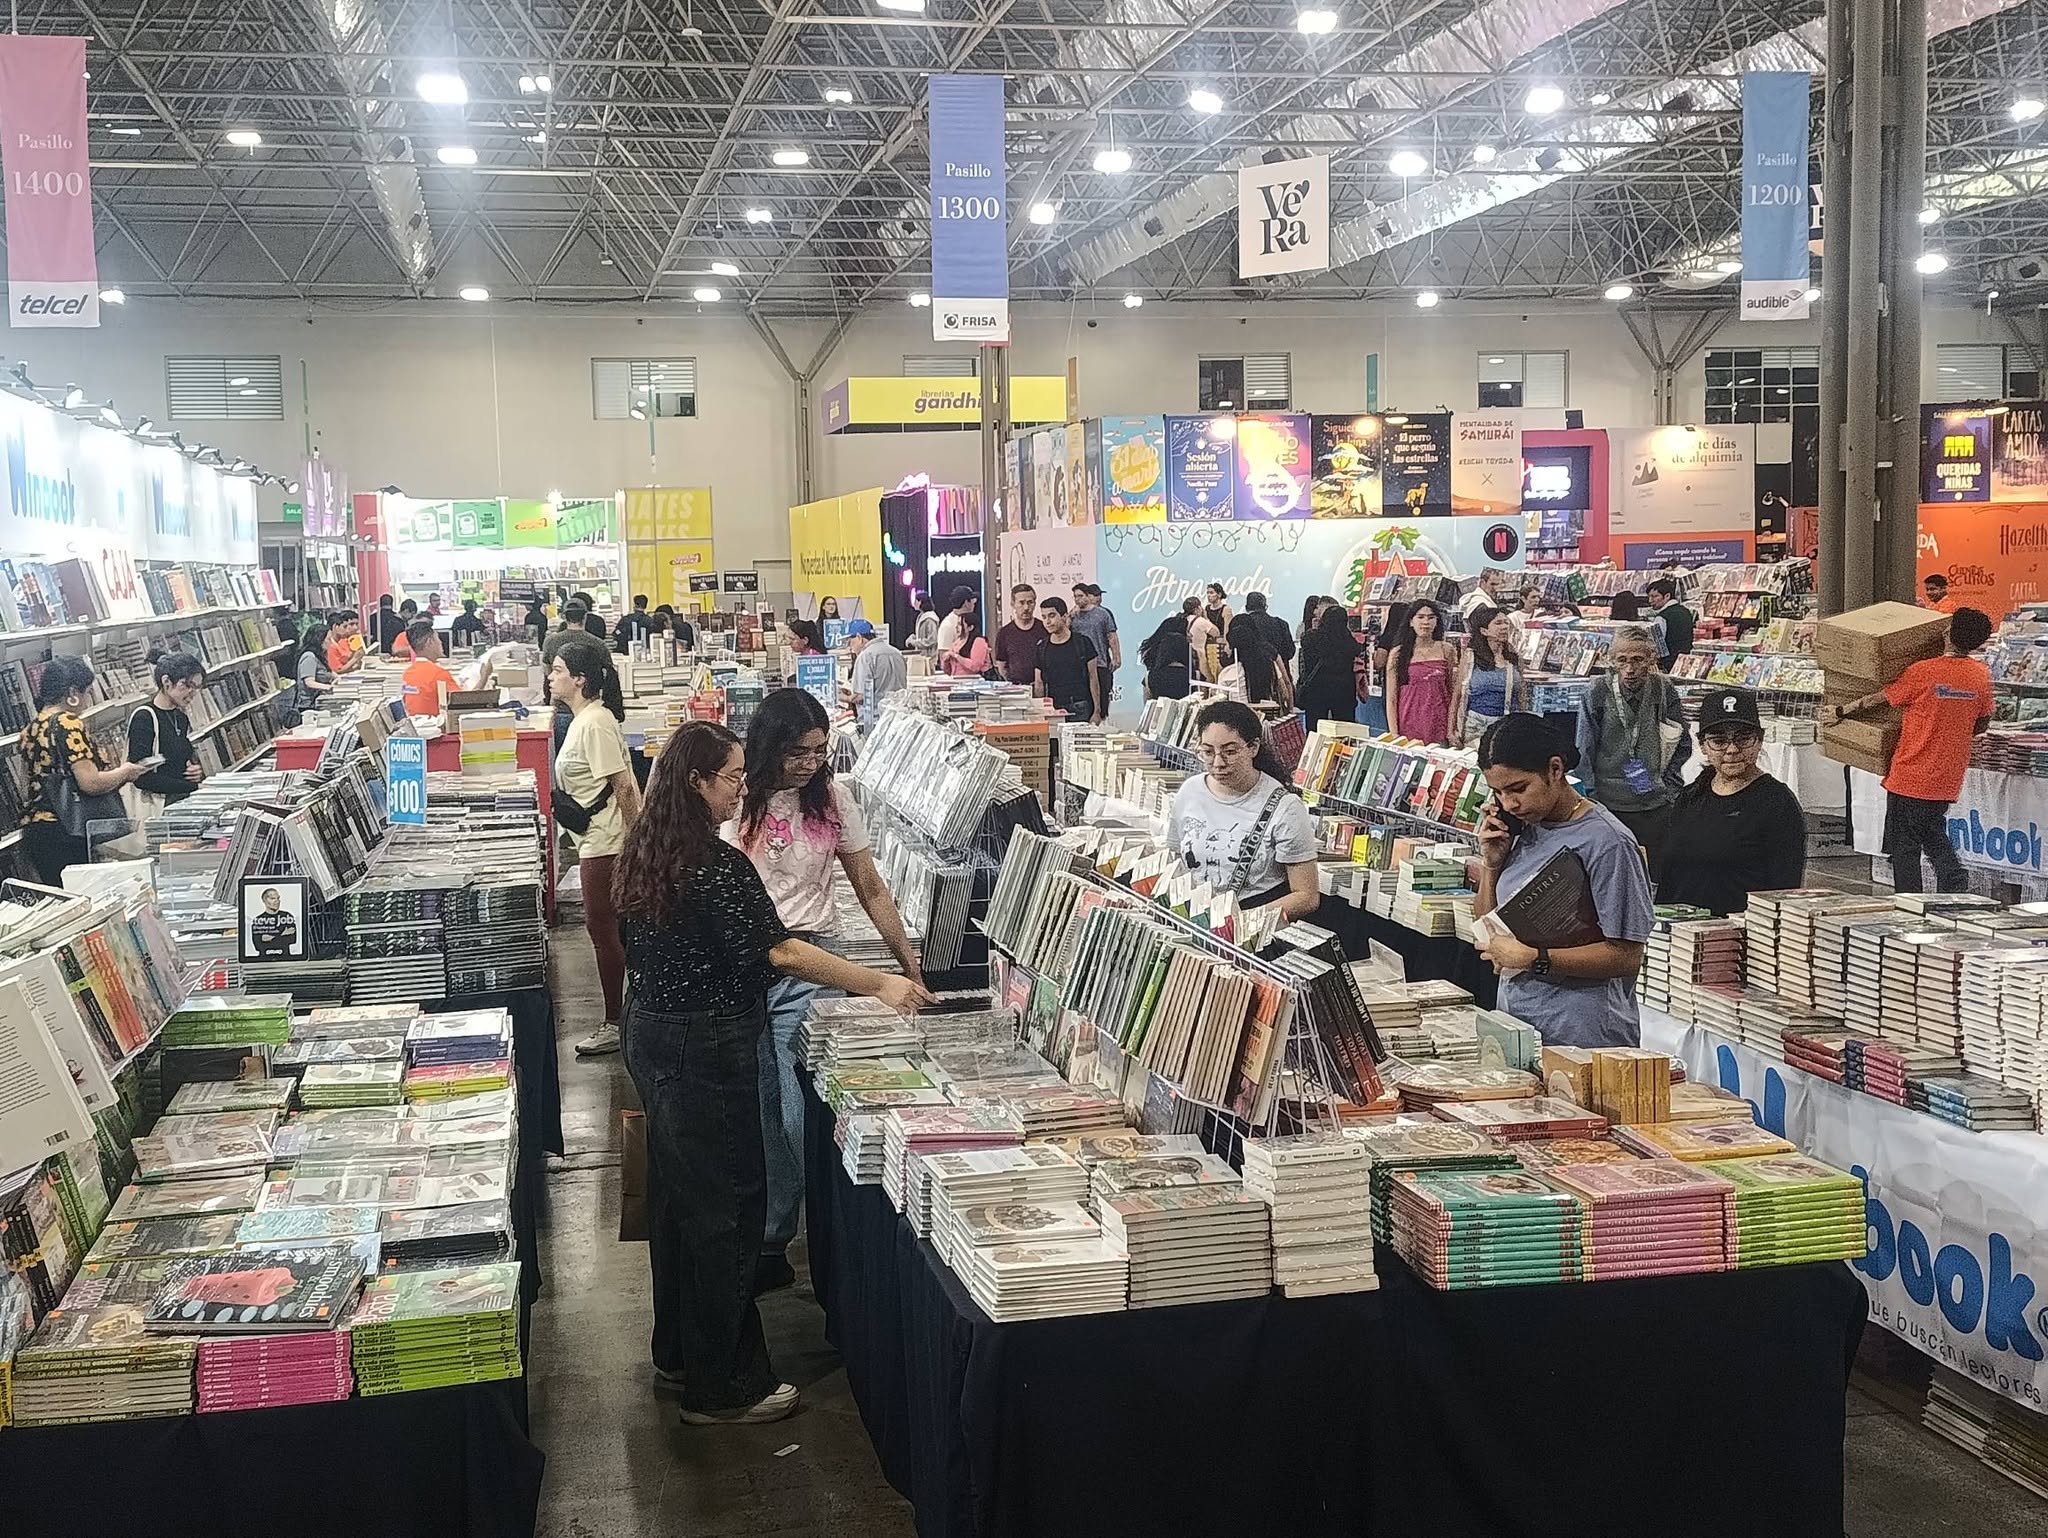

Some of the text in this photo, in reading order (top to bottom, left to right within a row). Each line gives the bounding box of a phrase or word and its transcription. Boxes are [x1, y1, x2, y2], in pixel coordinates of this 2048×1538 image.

[18, 133, 72, 149] Pasillo
[1757, 152, 1797, 166] Pasillo
[945, 163, 991, 178] Pasillo
[14, 171, 83, 196] 1400
[1749, 184, 1802, 206] 1200
[938, 196, 999, 219] 1300
[1260, 218, 1310, 255] Ra
[20, 294, 88, 315] telcel
[1747, 296, 1789, 308] audible
[962, 316, 997, 326] FRISA
[914, 391, 983, 413] gandhi
[1399, 432, 1432, 445] El perro
[1460, 427, 1514, 441] SAMURÁI
[1711, 436, 1737, 450] días
[1186, 452, 1217, 461] Sesión
[1394, 444, 1410, 454] que
[1185, 462, 1219, 471] abierta
[1393, 454, 1439, 463] las estrellas
[1689, 450, 1743, 467] alquimia
[1936, 463, 1982, 478] QUERIDAS
[1945, 475, 1974, 489] NIÑAS
[1494, 532, 1507, 553] N
[103, 548, 138, 600] CAJA
[1948, 573, 1996, 587] SCUROS
[390, 740, 421, 763] CÓMICS
[1518, 870, 1560, 910] POSTRES
[253, 915, 276, 926] teve
[1340, 962, 1355, 986] PECADO
[1355, 996, 1367, 1015] MESA
[1334, 1034, 1351, 1069] POSTRES
[1346, 1036, 1360, 1061] SOPAS
[1354, 1031, 1368, 1056] SOPAS
[298, 1259, 342, 1319] smoothies
[1961, 1350, 2042, 1405] lectores
